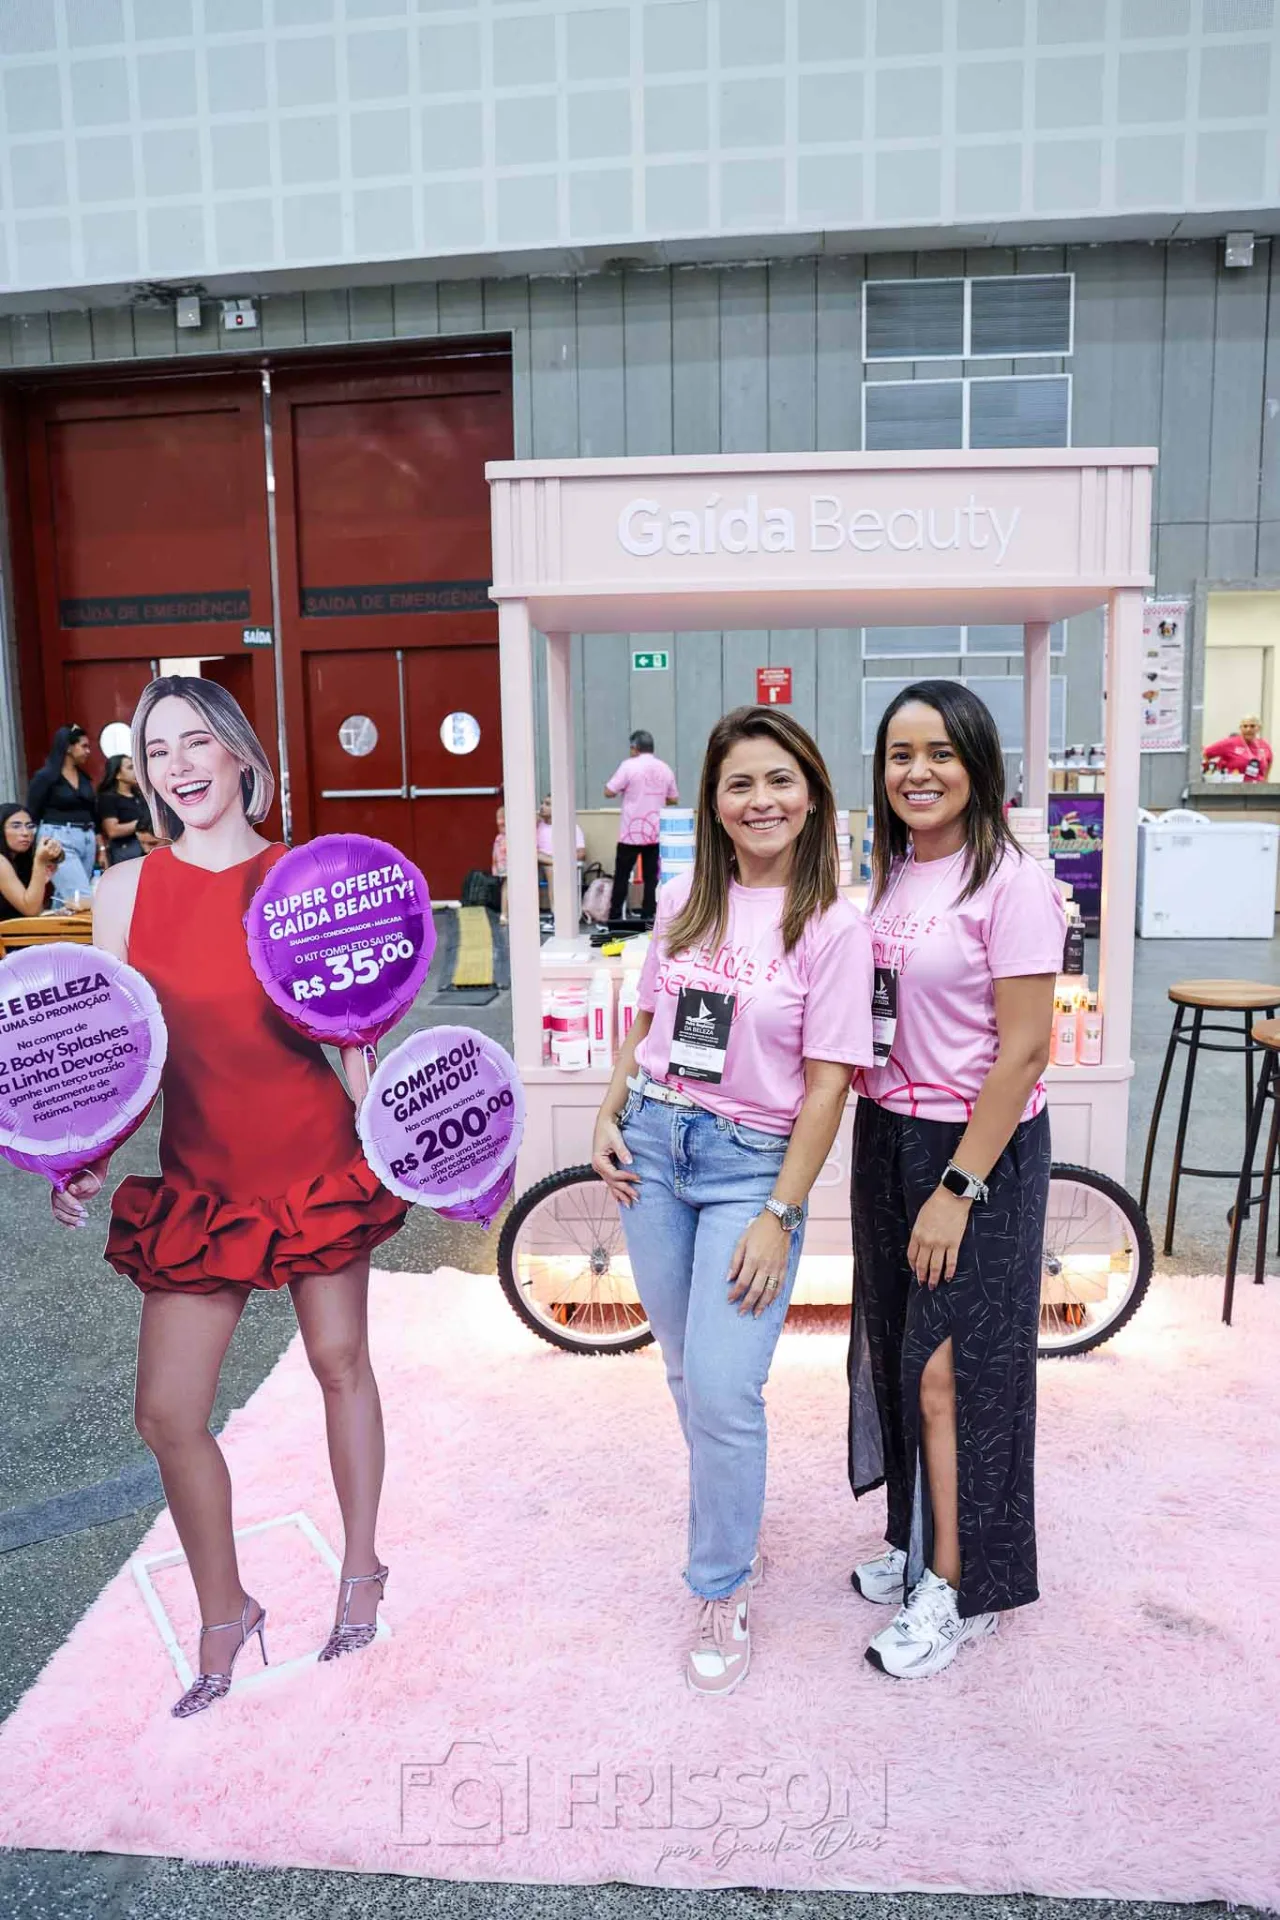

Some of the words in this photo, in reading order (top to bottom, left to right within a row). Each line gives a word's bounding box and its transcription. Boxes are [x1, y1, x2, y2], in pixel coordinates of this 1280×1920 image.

[617, 492, 795, 556] Gaída
[809, 494, 1021, 567] Beauty
[389, 588, 489, 607] EMERGÊNC
[243, 628, 272, 644] SAÍDA
[263, 887, 328, 921] SUPER
[330, 863, 405, 899] OFERTA
[269, 907, 332, 940] GAÍDA
[333, 879, 415, 920] BEAUTY!
[289, 934, 320, 947] SHAMPOO
[323, 922, 372, 940] CONDICIONADOR
[374, 915, 403, 927] MÁSCARA
[294, 954, 304, 964] O
[304, 950, 319, 962] KIT
[319, 939, 370, 959] COMPLETO
[370, 935, 385, 947] SAI
[385, 931, 405, 943] POR
[292, 974, 326, 1001] R$
[325, 939, 414, 991] 35,00
[2, 1018, 29, 1033] UMA
[29, 1011, 44, 1025] SÓ
[45, 992, 111, 1020] PROMOÇÃO!
[8, 997, 24, 1016] E
[25, 973, 110, 1011] BELEZA
[0, 1062, 9, 1077] 2
[10, 1048, 55, 1071] Body
[56, 1025, 129, 1057] Splashes
[17, 1039, 33, 1050] Na
[34, 1027, 73, 1045] compra
[74, 1022, 88, 1033] de
[693, 1027, 714, 1035] BELEZA
[0, 1083, 11, 1095] a
[12, 1066, 60, 1091] Linha
[61, 1042, 139, 1074] Devoção,
[9, 1088, 43, 1107] ganhe
[43, 1082, 60, 1094] um
[61, 1074, 88, 1087] terço
[88, 1061, 125, 1078] trazido
[381, 1039, 481, 1107] COMPROU,
[32, 1083, 96, 1110] diretamente
[96, 1078, 111, 1088] de
[33, 1105, 73, 1123] Fátima,
[72, 1087, 120, 1109] Portugal!
[393, 1059, 479, 1122] GANHOU!
[404, 1121, 421, 1133] Nas
[421, 1105, 453, 1126] compras
[452, 1094, 475, 1110] acima
[475, 1088, 486, 1098] de
[390, 1152, 419, 1179] R$
[415, 1089, 514, 1163] 200,00
[431, 1154, 455, 1171] ganhe
[455, 1145, 472, 1158] uma
[471, 1134, 492, 1149] blusa
[419, 1176, 430, 1185] ou
[429, 1167, 448, 1180] uma
[447, 1152, 476, 1170] ecobag
[437, 1175, 448, 1185] da
